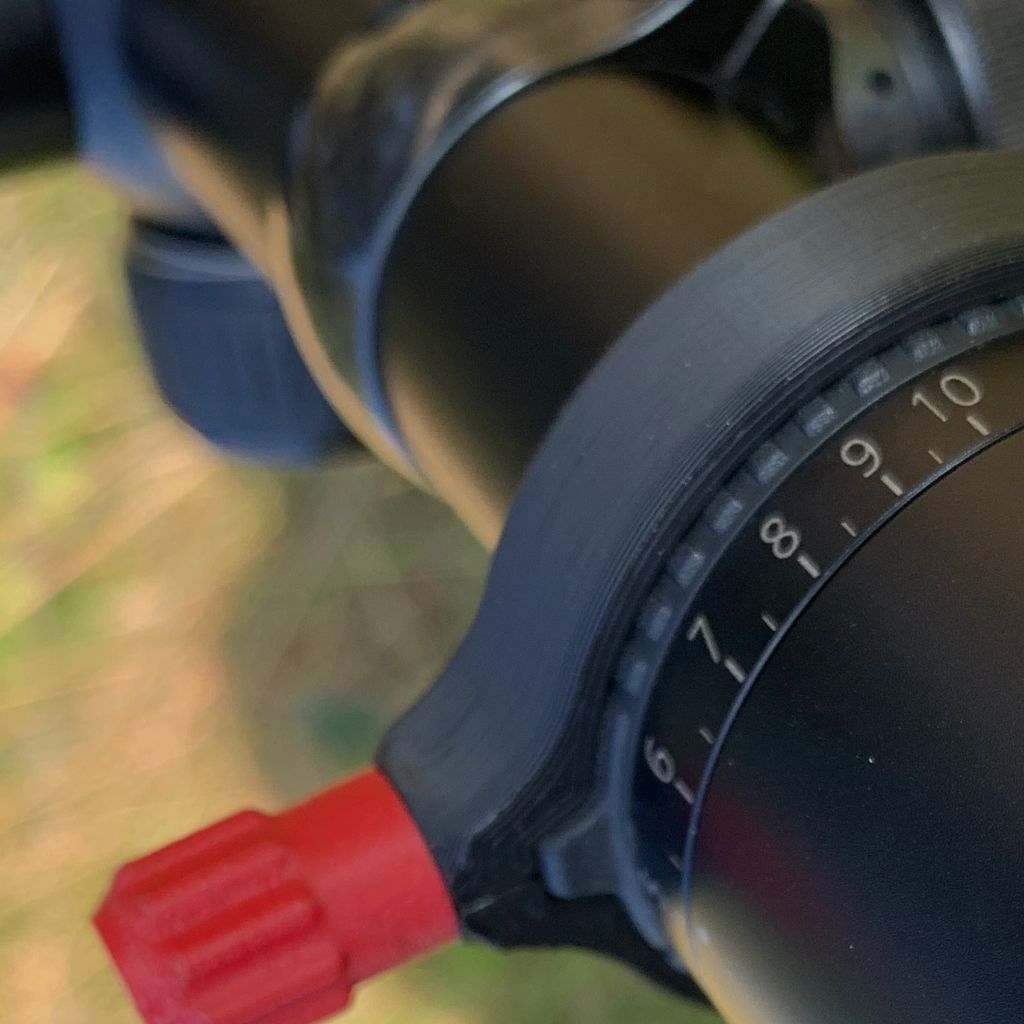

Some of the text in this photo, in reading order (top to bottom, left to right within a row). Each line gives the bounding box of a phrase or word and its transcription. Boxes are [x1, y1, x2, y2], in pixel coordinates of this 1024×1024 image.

[912, 374, 982, 422] 10
[840, 439, 881, 478] 9
[760, 515, 800, 559] 8
[687, 614, 721, 663] 7
[644, 736, 676, 783] 6
